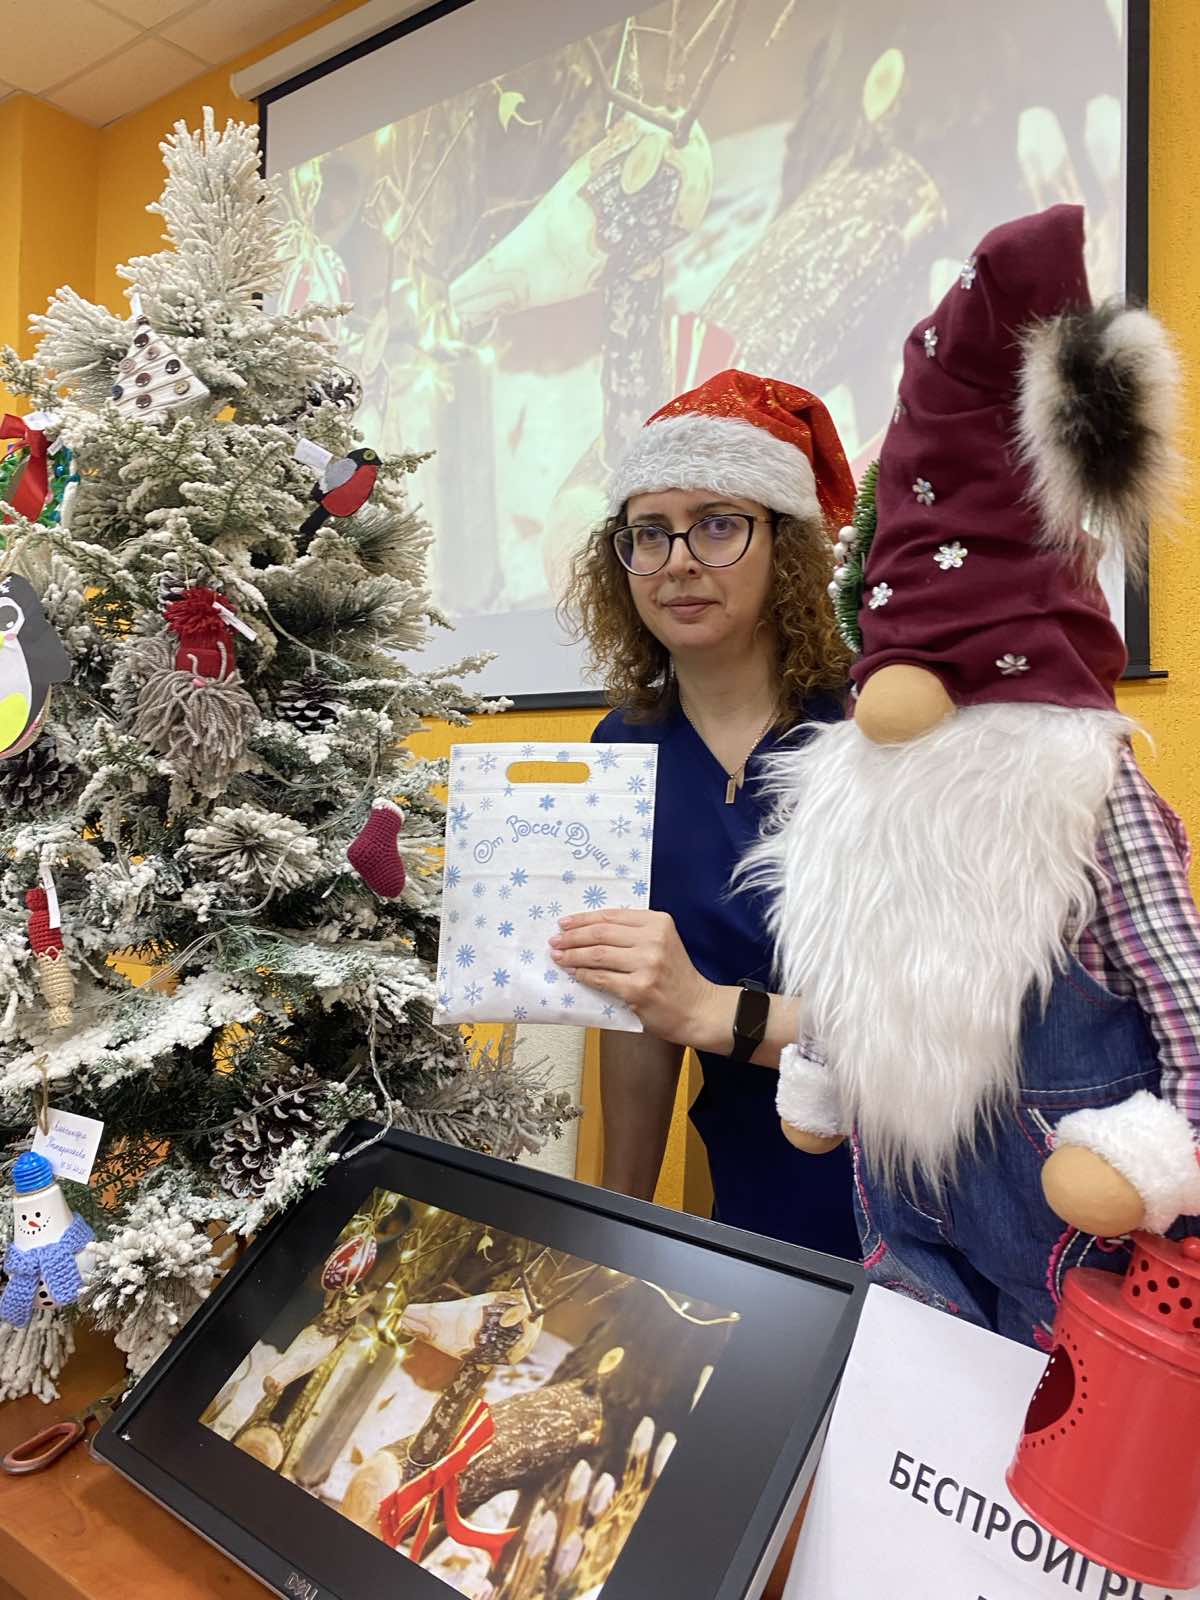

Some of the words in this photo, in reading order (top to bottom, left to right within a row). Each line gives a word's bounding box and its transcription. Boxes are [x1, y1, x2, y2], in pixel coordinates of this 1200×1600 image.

[473, 836, 505, 864] От
[505, 814, 563, 844] Всей
[564, 821, 611, 870] Души
[888, 1450, 1174, 1600] БЕСПРОИГР
